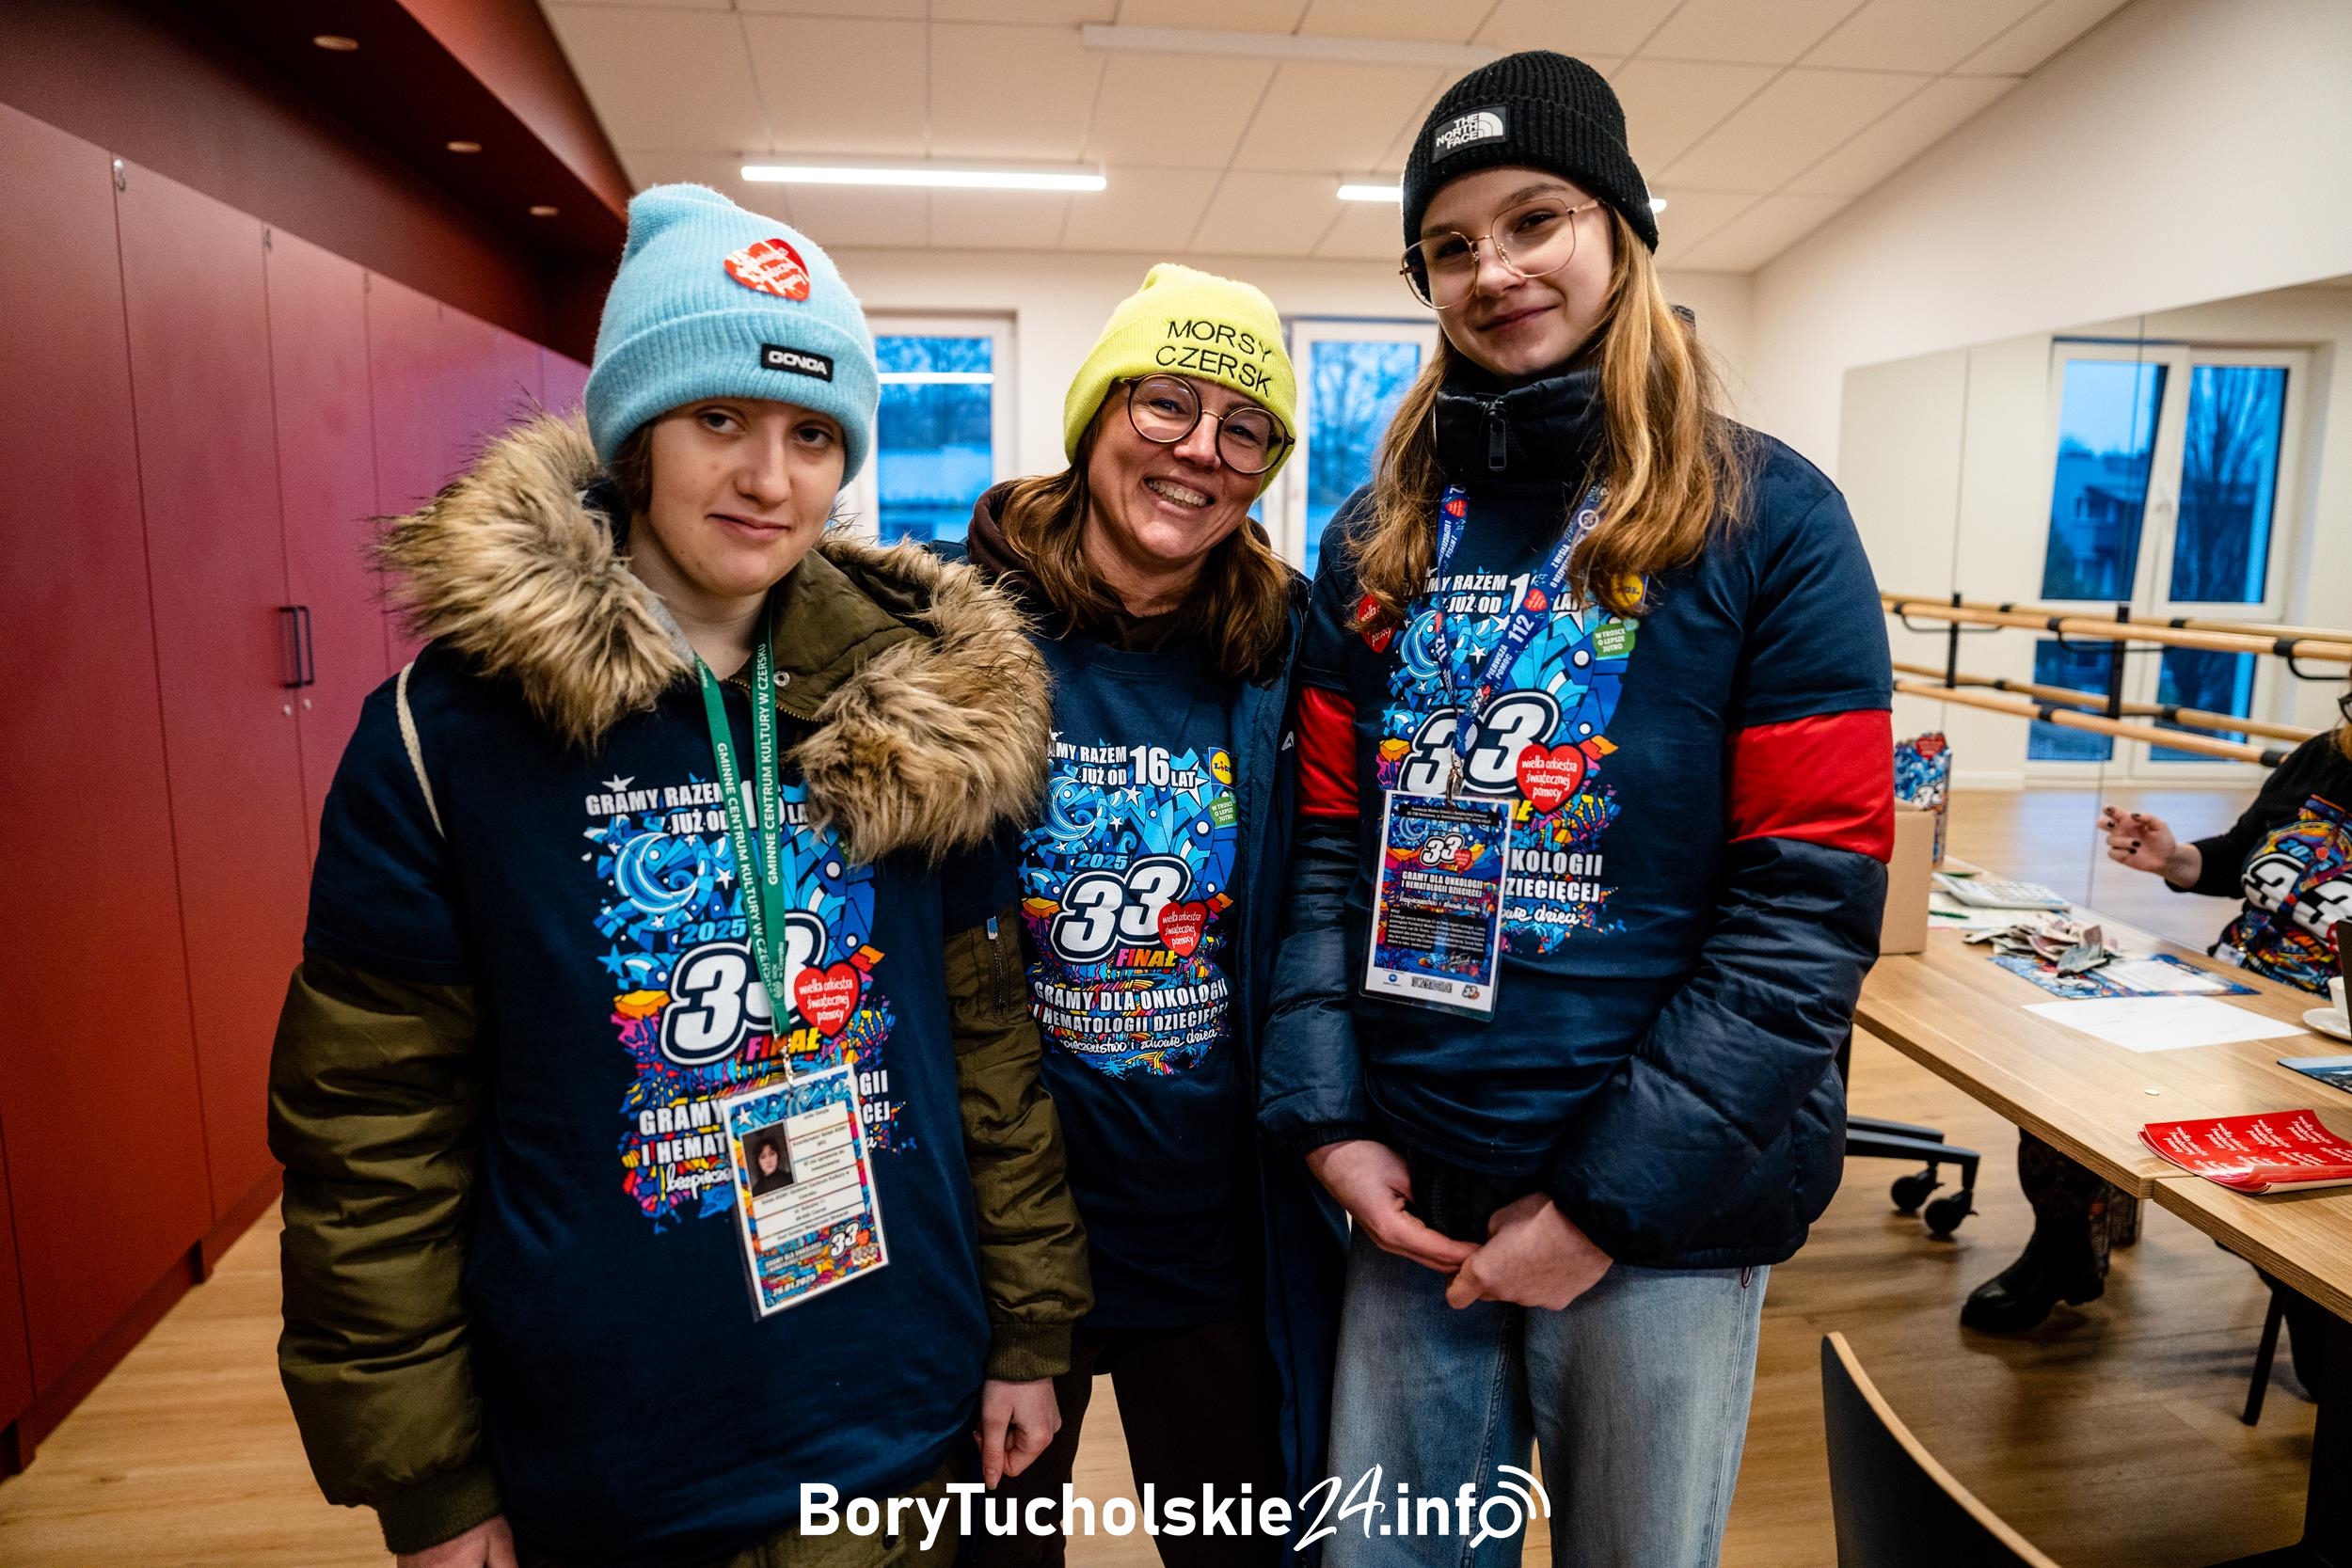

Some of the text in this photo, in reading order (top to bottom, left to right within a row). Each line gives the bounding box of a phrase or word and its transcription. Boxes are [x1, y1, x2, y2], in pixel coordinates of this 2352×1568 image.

[1436, 121, 1478, 148] NORTH
[1454, 113, 1479, 128] THE
[1447, 132, 1478, 150] FACE
[1168, 320, 1273, 363] MORSY
[1156, 345, 1272, 398] CZERSK
[1447, 593, 1475, 612] JUŻ
[1478, 595, 1502, 614] OD
[1453, 574, 1508, 592] RAZEM
[1510, 573, 1530, 614] 1
[1508, 614, 1534, 643] 112
[1486, 644, 1508, 680] PIERWSZA
[1496, 654, 1513, 680] POMOC
[1399, 692, 1561, 794] 33
[757, 642, 779, 886] GMINNE CENTRUM KULTURY W CZERSKU
[1047, 741, 1170, 786] AMY RAZEM 16
[1080, 767, 1196, 788] JUŻ OD LAT
[585, 788, 660, 816] GRAMY
[1532, 786, 1563, 802] pomocy
[671, 808, 705, 836] JUŻ
[787, 803, 809, 825] LA
[717, 742, 737, 797] GMINNE
[727, 797, 749, 863] CENTRUM
[740, 863, 762, 922] KULTURY
[753, 922, 764, 936] W
[1421, 833, 1465, 866] 33
[1075, 852, 1128, 871] 2025
[1511, 848, 1603, 877] KOLOGII
[1505, 877, 1600, 903] ZIECIĘCEJ
[1051, 857, 1192, 961] 33
[1534, 903, 1581, 926] dzieci
[679, 917, 747, 944] 2025
[1171, 936, 1194, 949] pomocy
[1116, 948, 1178, 968] FINAŁ
[661, 912, 826, 1065] 33
[1035, 977, 1229, 1012] GRAMY DLA ONKOLOGII
[817, 1008, 845, 1026] pomocy
[1042, 1006, 1148, 1034] HEMATOLOGII
[745, 1026, 821, 1062] FINAŁ
[640, 1099, 724, 1137] GRAMY
[642, 1144, 651, 1166] I
